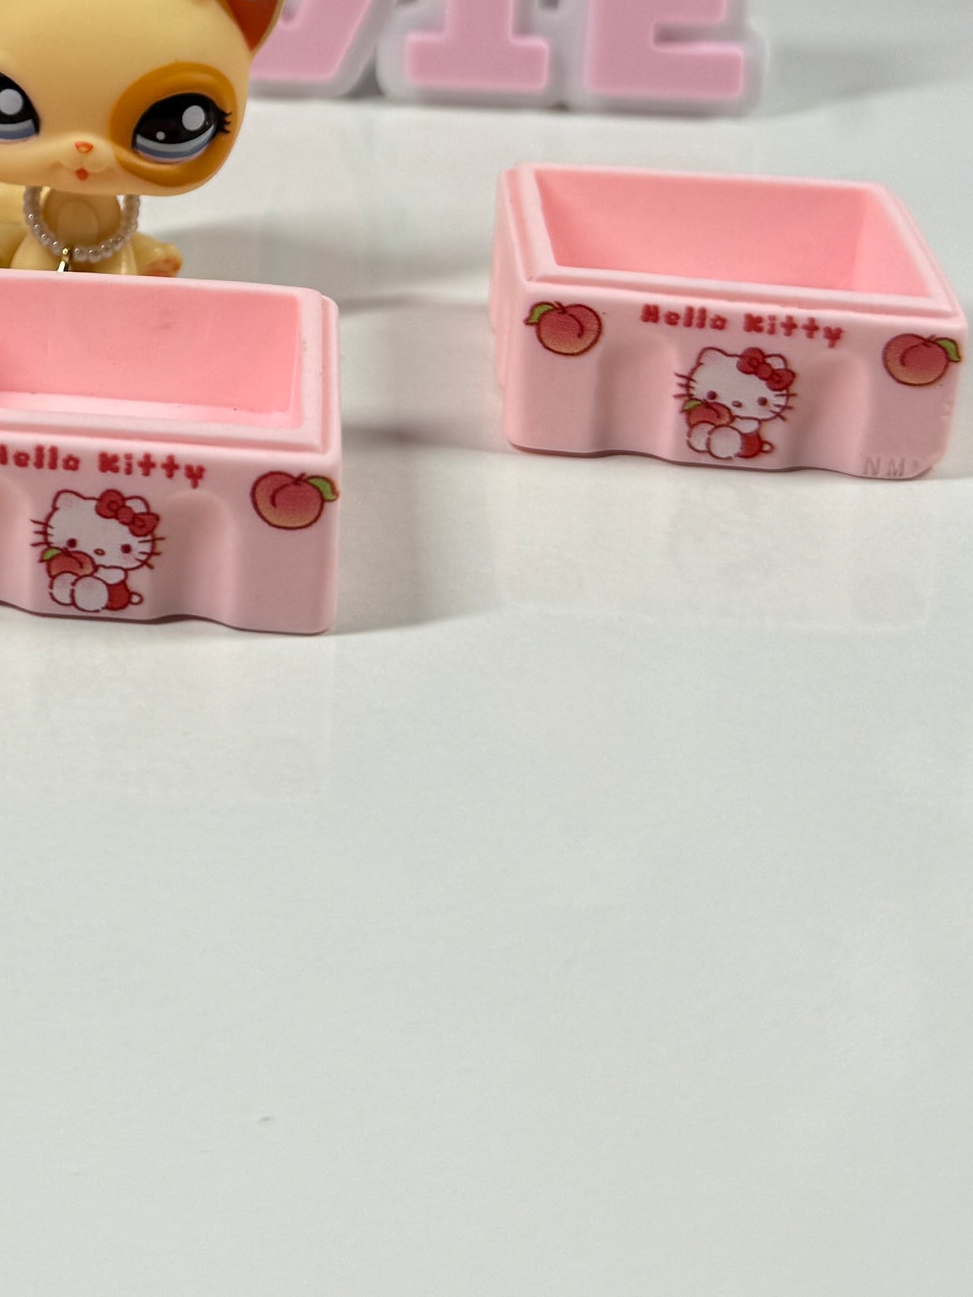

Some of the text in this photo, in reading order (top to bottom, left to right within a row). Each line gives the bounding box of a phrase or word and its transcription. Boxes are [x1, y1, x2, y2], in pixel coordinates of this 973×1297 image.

[639, 302, 845, 349] Hello Kitty
[96, 451, 208, 490] Kitty
